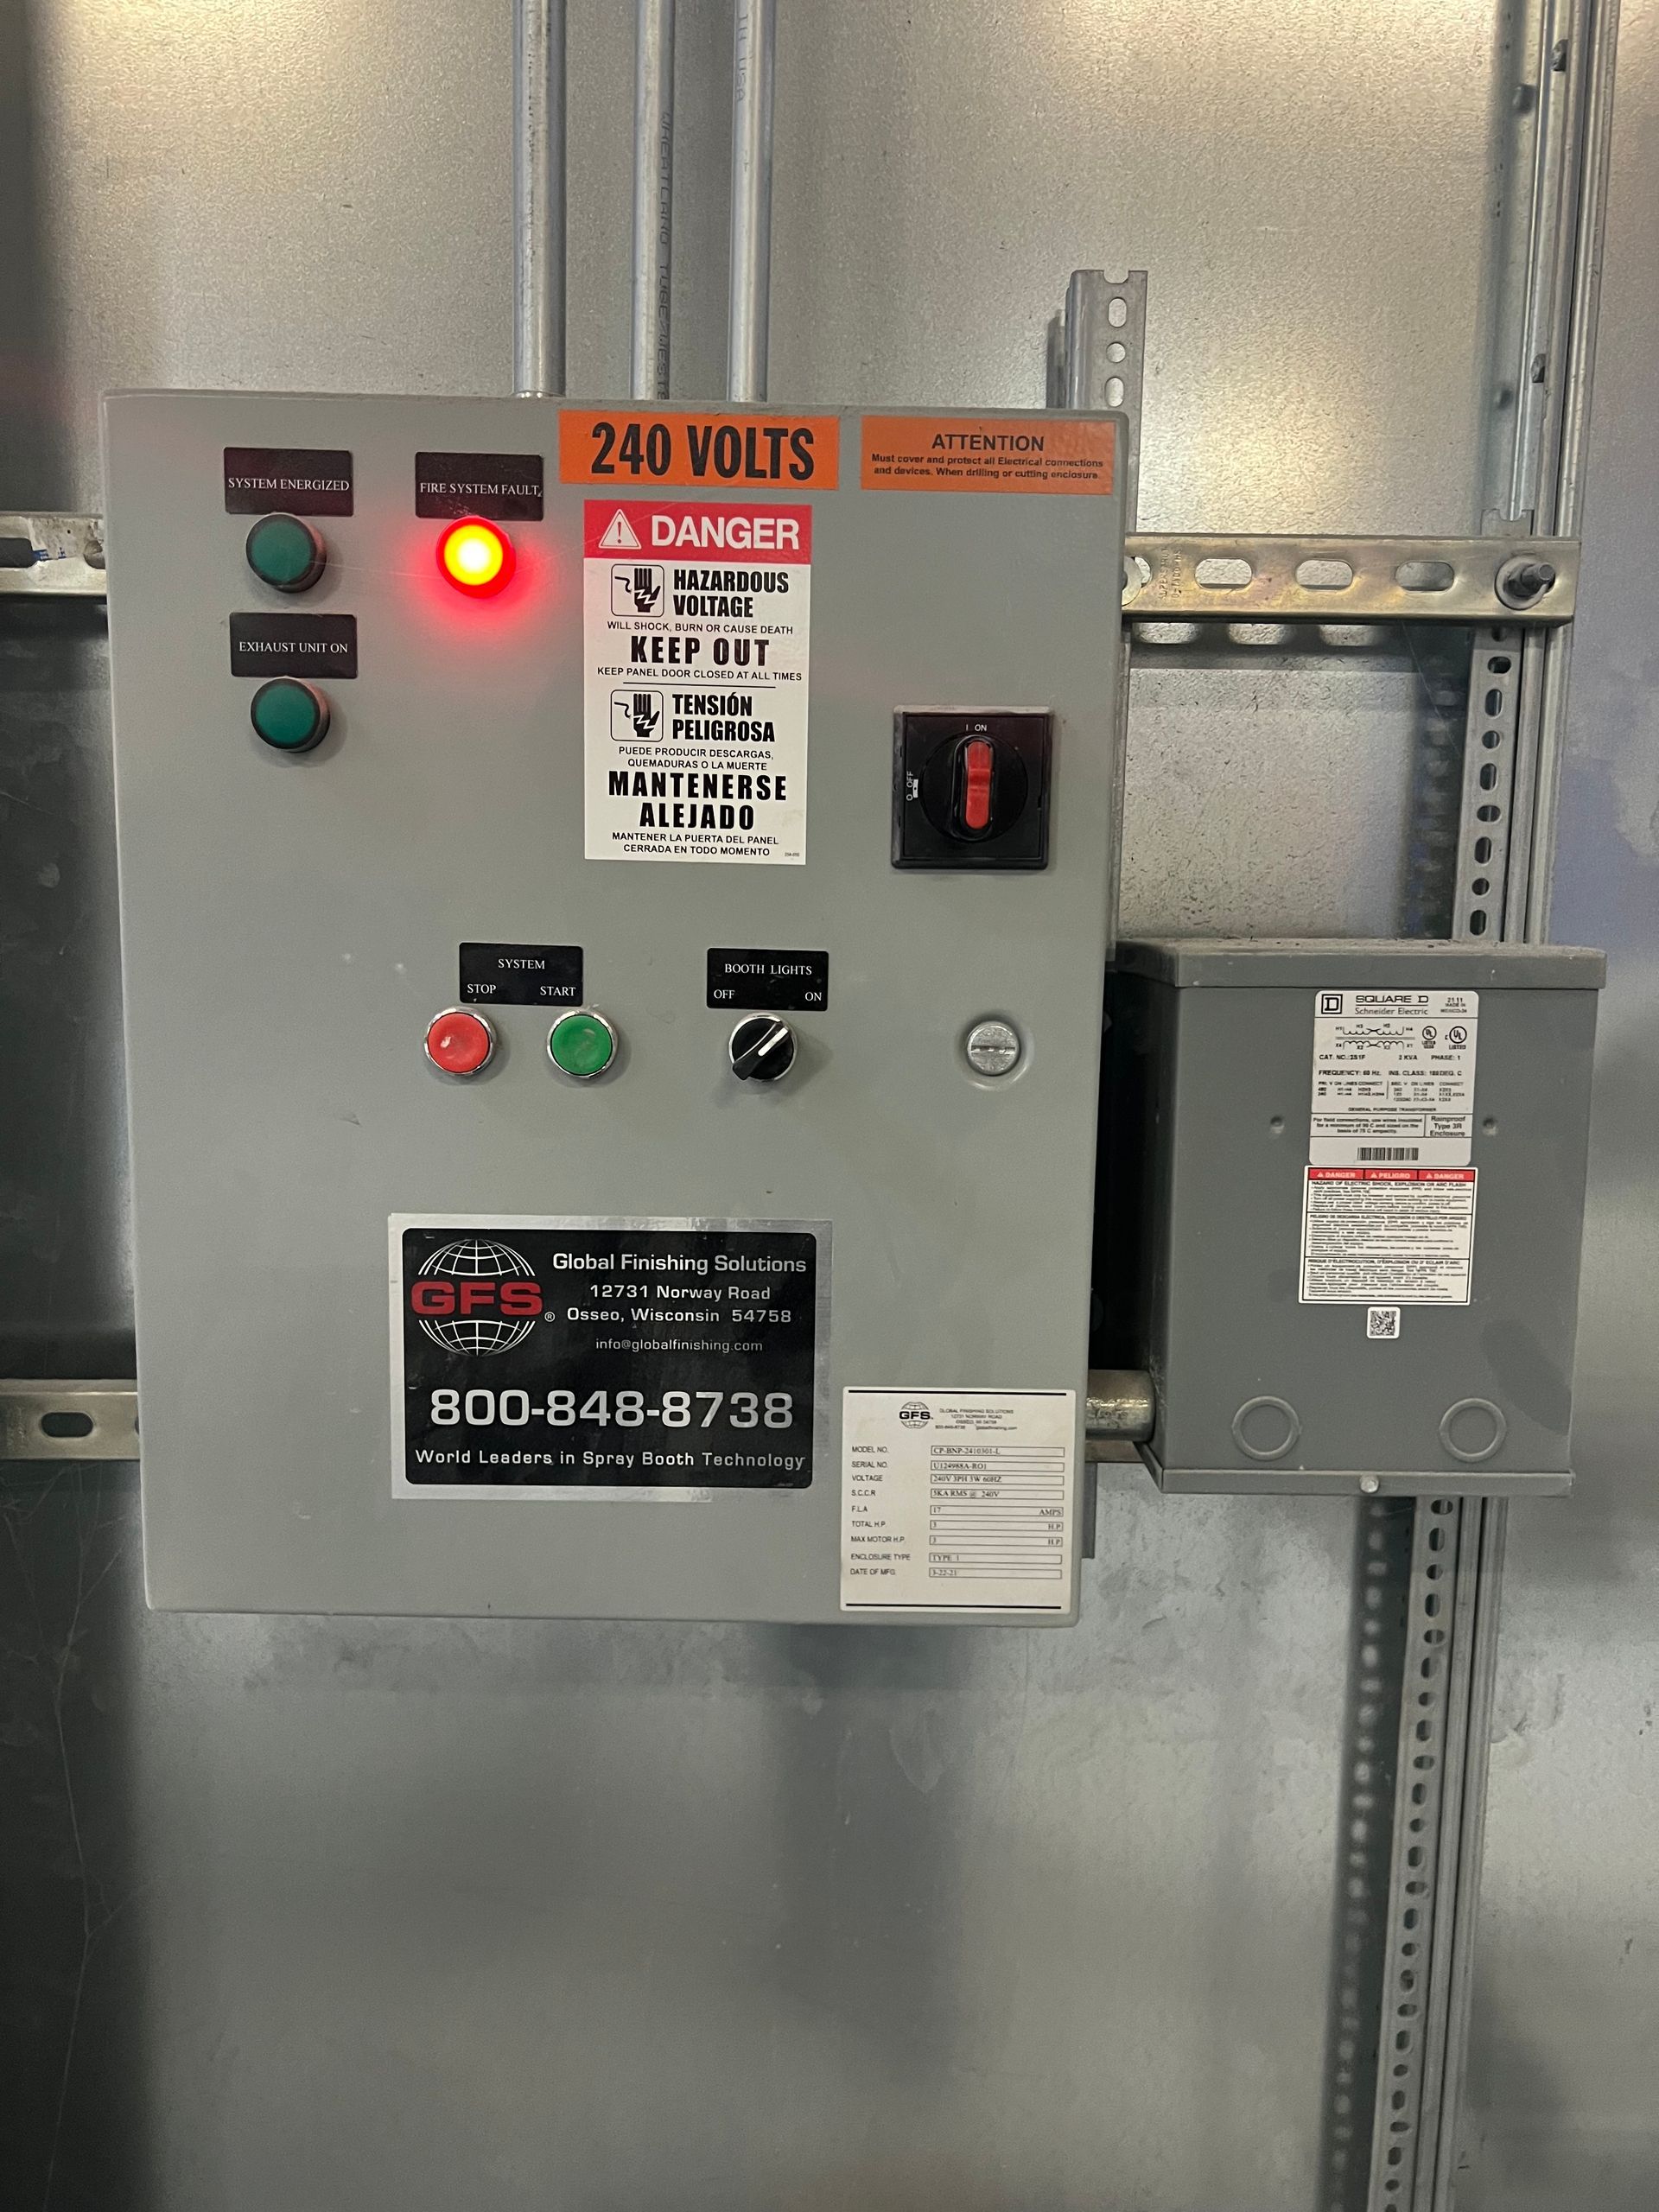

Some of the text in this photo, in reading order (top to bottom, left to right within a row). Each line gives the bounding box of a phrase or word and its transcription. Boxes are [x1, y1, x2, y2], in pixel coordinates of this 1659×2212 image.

[658, 111, 671, 245] WHEATLAND
[591, 422, 814, 480] 240 VOLTS
[931, 434, 1044, 451] ATTENTION
[872, 454, 894, 462] Must
[927, 455, 944, 464] and
[948, 456, 981, 467] protect
[998, 457, 1042, 466] Electrical
[1046, 459, 1103, 467] connections
[874, 467, 891, 475] and
[937, 467, 963, 476] When
[967, 468, 999, 478] drilling
[1015, 469, 1047, 480] cutting
[229, 478, 349, 492] SYSTEM ENERGIZED
[420, 482, 539, 496] FIRE SYSTEM FAULT
[652, 515, 799, 550] DANGER
[673, 569, 789, 594] HAZARDOUS
[673, 594, 753, 618] VOLTAGE
[607, 621, 792, 635] WILL SHOCK, BURN OR CAUSE DEATH
[238, 641, 348, 654] EXHAUST UNIT ON
[631, 636, 769, 666] KEEP OUT
[597, 666, 802, 681] KEEP PANEL DOOR CLOSED AT ALL TIMES
[672, 691, 752, 717] TENSIÓN
[673, 719, 775, 742] PELIGROSA
[619, 747, 774, 760] PUEDE PRODUCIR DESCARGAS,
[627, 759, 767, 771] QUEMADURAS O LA MUERTE
[609, 771, 786, 801] MANTENERSE
[639, 802, 754, 830] ALEJADO
[612, 832, 779, 845] MANTENER LA PUERTA DEL PANEL
[624, 843, 770, 856] CERRADA EN TODO MOMENTO
[498, 958, 545, 969] SYSTEM
[724, 963, 812, 976] BOOTH LIGHTS
[467, 983, 575, 997] STOP START
[714, 988, 823, 1002] OFF ON
[553, 1253, 807, 1276] Global Finishing Solutions
[410, 1281, 543, 1317] GFS
[590, 1284, 771, 1302] 12731 Norway Road
[567, 1307, 791, 1325] Osseo, Wisconsin 54758
[595, 1337, 763, 1354] info@globalfinishing.com
[431, 1388, 793, 1429] 800-848-8738
[899, 1410, 931, 1421] GFS
[416, 1450, 806, 1471] World Leaders in Spray Booth Technology
